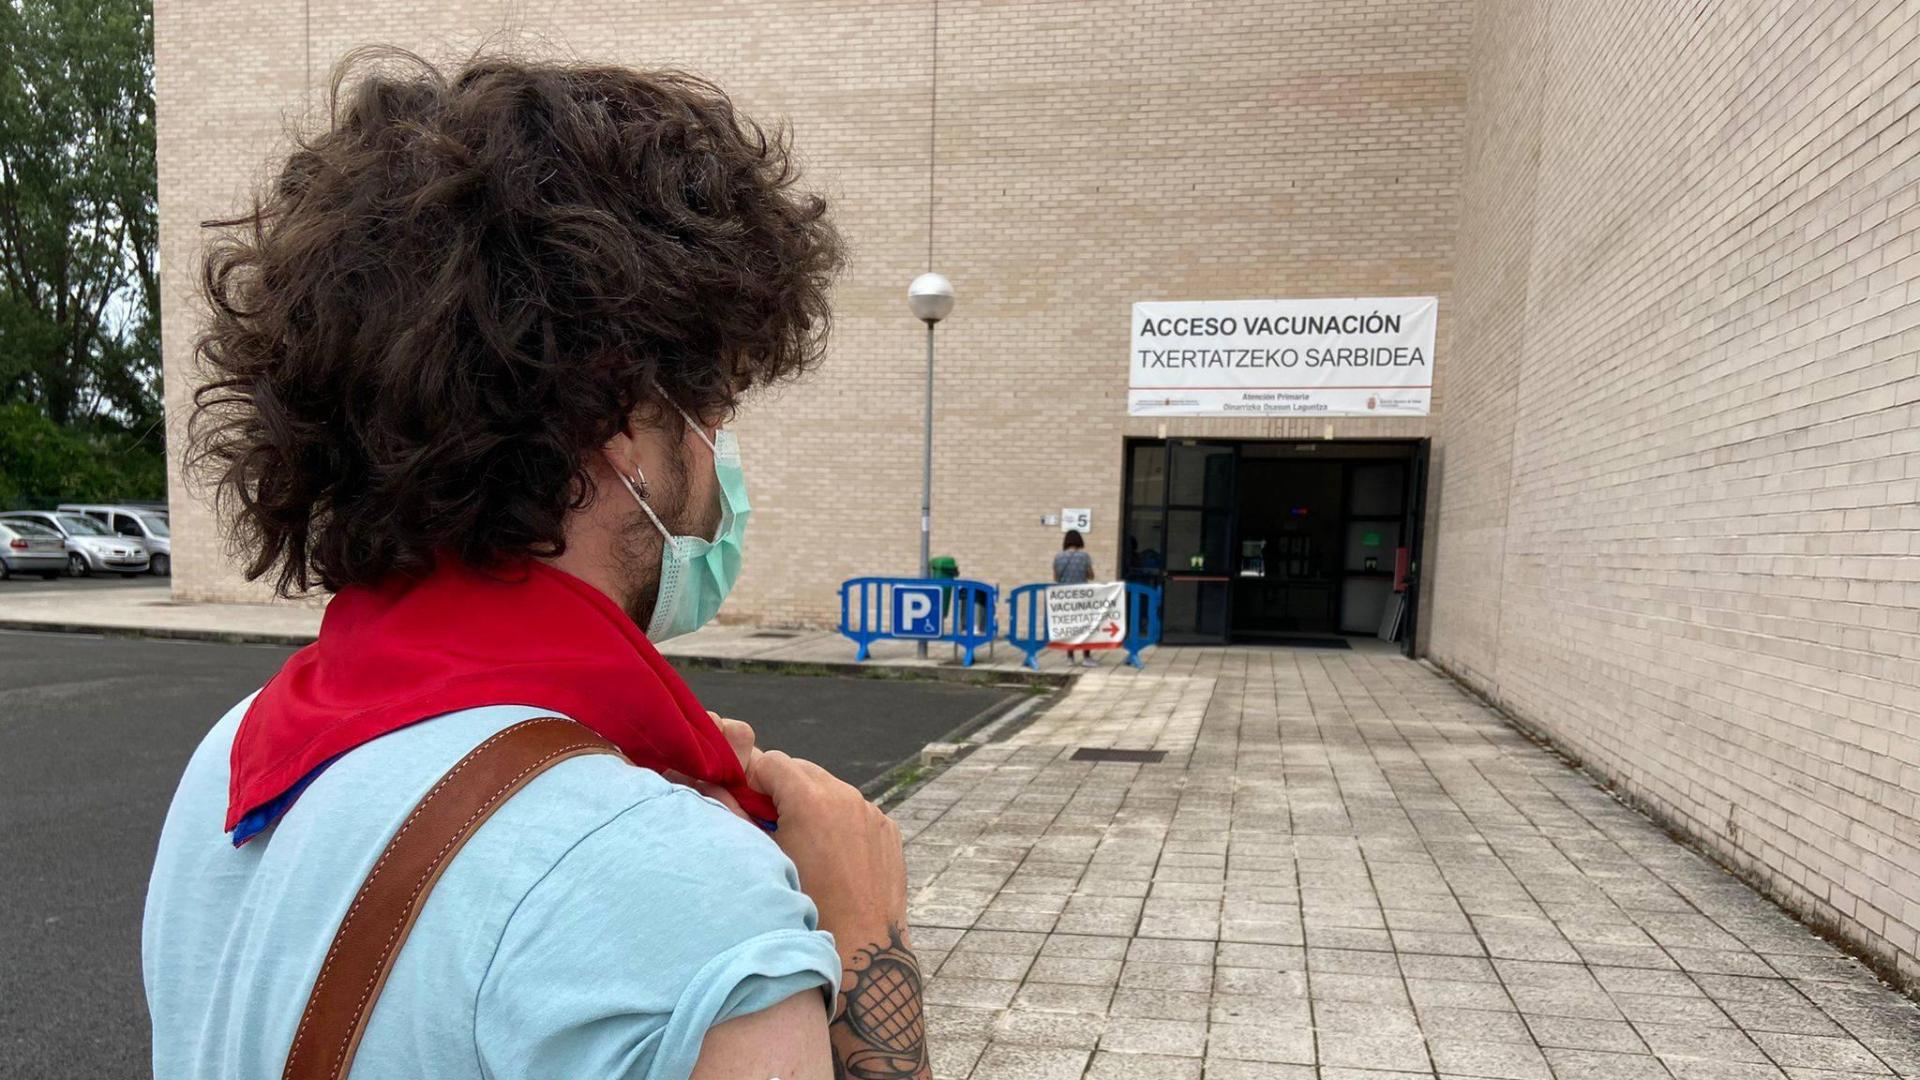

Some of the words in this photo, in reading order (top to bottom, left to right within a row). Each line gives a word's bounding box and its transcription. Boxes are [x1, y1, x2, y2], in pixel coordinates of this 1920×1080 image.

[1140, 317, 1236, 337] ACCESO
[1243, 311, 1401, 336] VACUNACIÓN
[1138, 348, 1299, 368] TXERTATZEKO
[1305, 347, 1425, 368] SARBIDEA
[1077, 514, 1087, 527] 5
[1050, 589, 1094, 599] ACCESO
[902, 592, 932, 631] P
